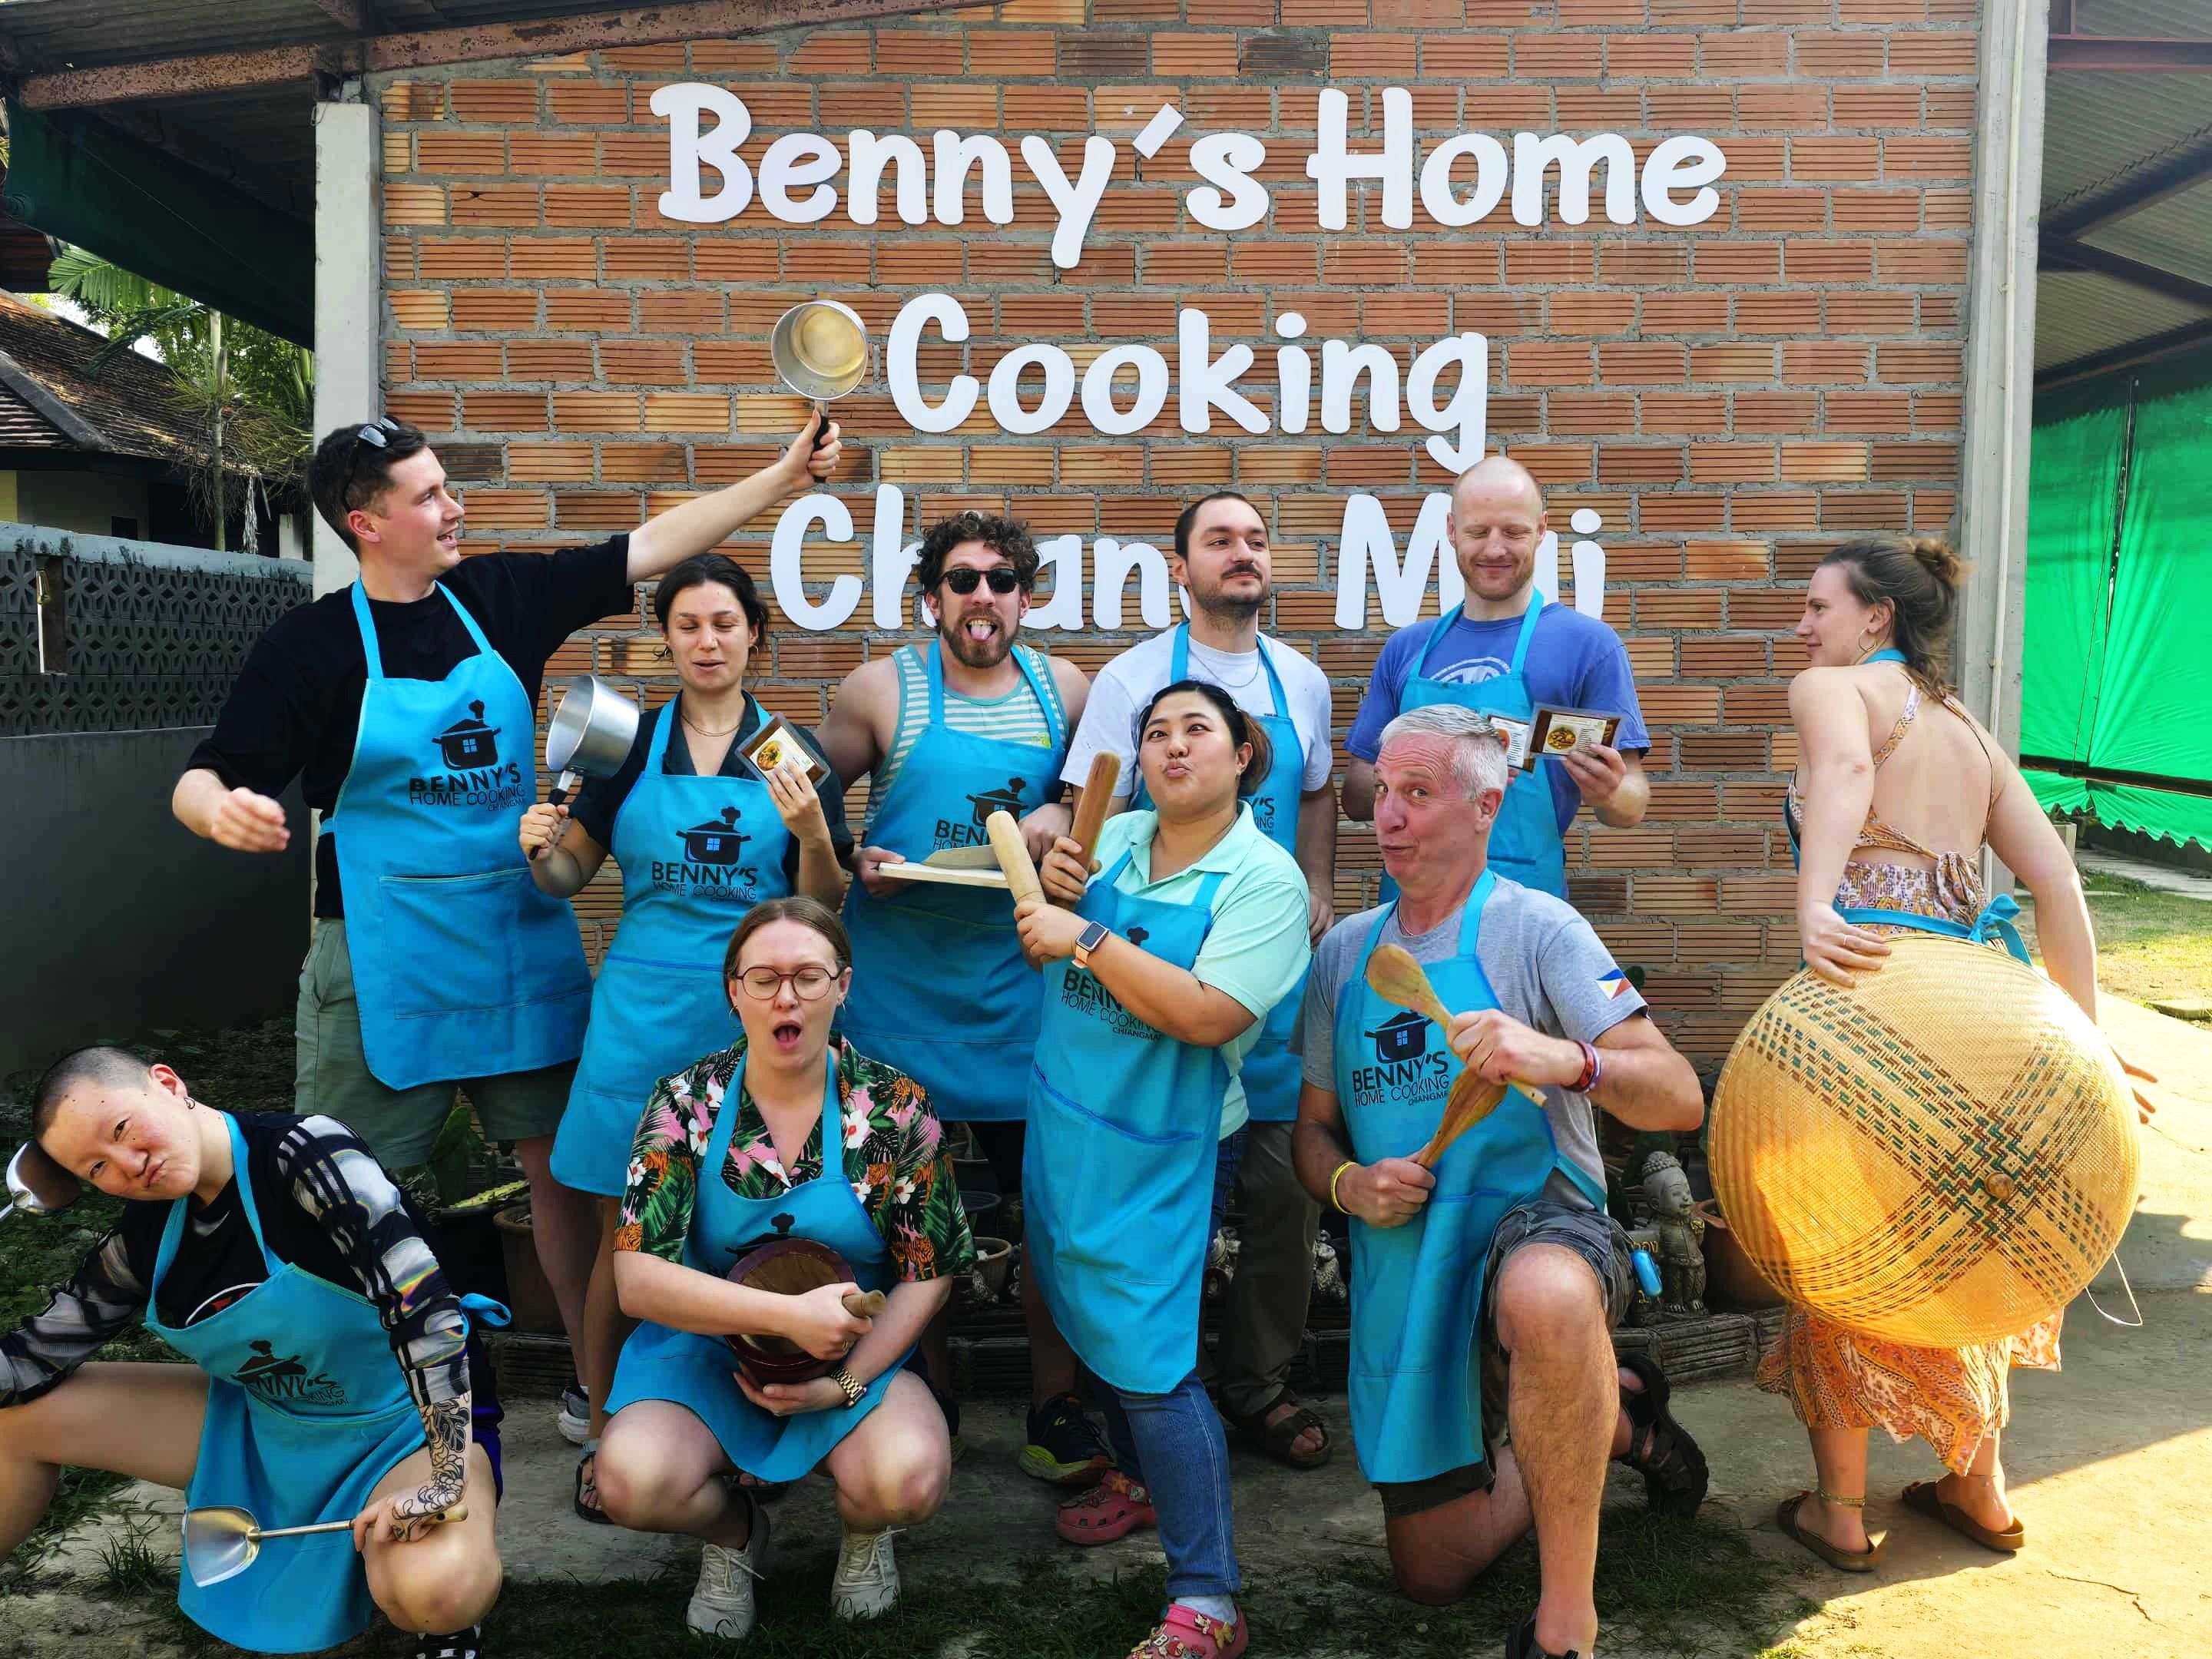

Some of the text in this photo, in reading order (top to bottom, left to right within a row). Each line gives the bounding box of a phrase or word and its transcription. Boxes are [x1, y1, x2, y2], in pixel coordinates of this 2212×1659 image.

[650, 83, 1726, 268] Benny's Home
[887, 293, 1488, 475] Cooking
[409, 762, 522, 792] BENNY'S
[410, 783, 525, 806] HOME COOKING
[651, 861, 758, 887] BENNY'S
[653, 881, 757, 899] HOME COOKING
[1061, 989, 1096, 1015] HOME
[1353, 1051, 1449, 1093] BENNY'S
[1355, 1074, 1450, 1107] HOME COOKING
